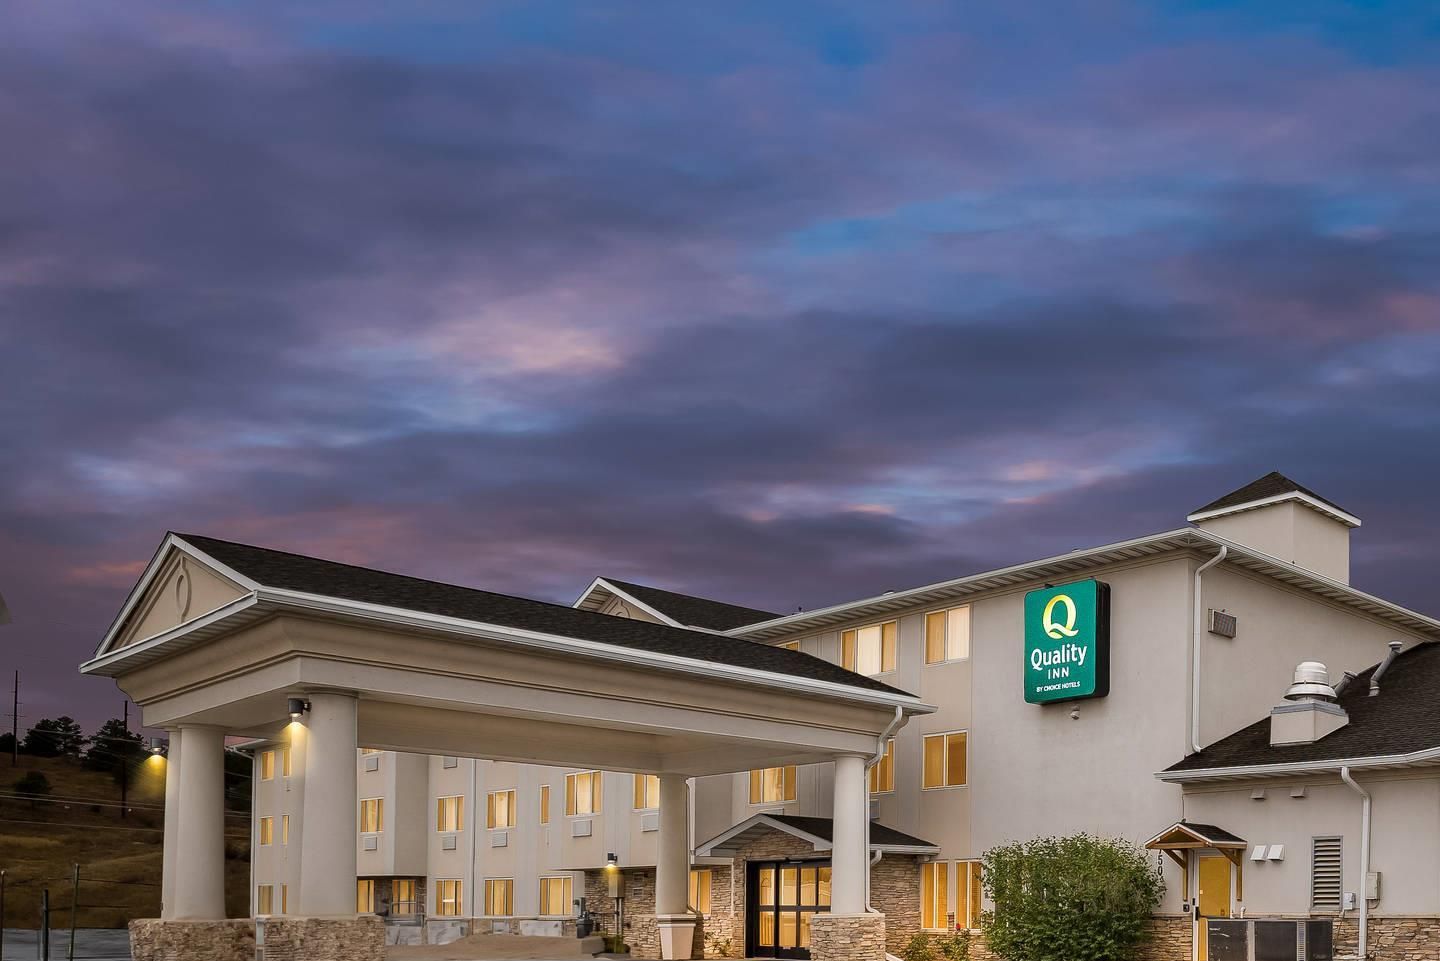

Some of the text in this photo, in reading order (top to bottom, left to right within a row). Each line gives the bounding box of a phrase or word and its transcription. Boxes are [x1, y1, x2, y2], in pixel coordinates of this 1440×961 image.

[1043, 594, 1079, 639] Q
[1031, 644, 1087, 671] Quality
[1048, 666, 1069, 679] INN
[1043, 683, 1061, 691] CHOICE
